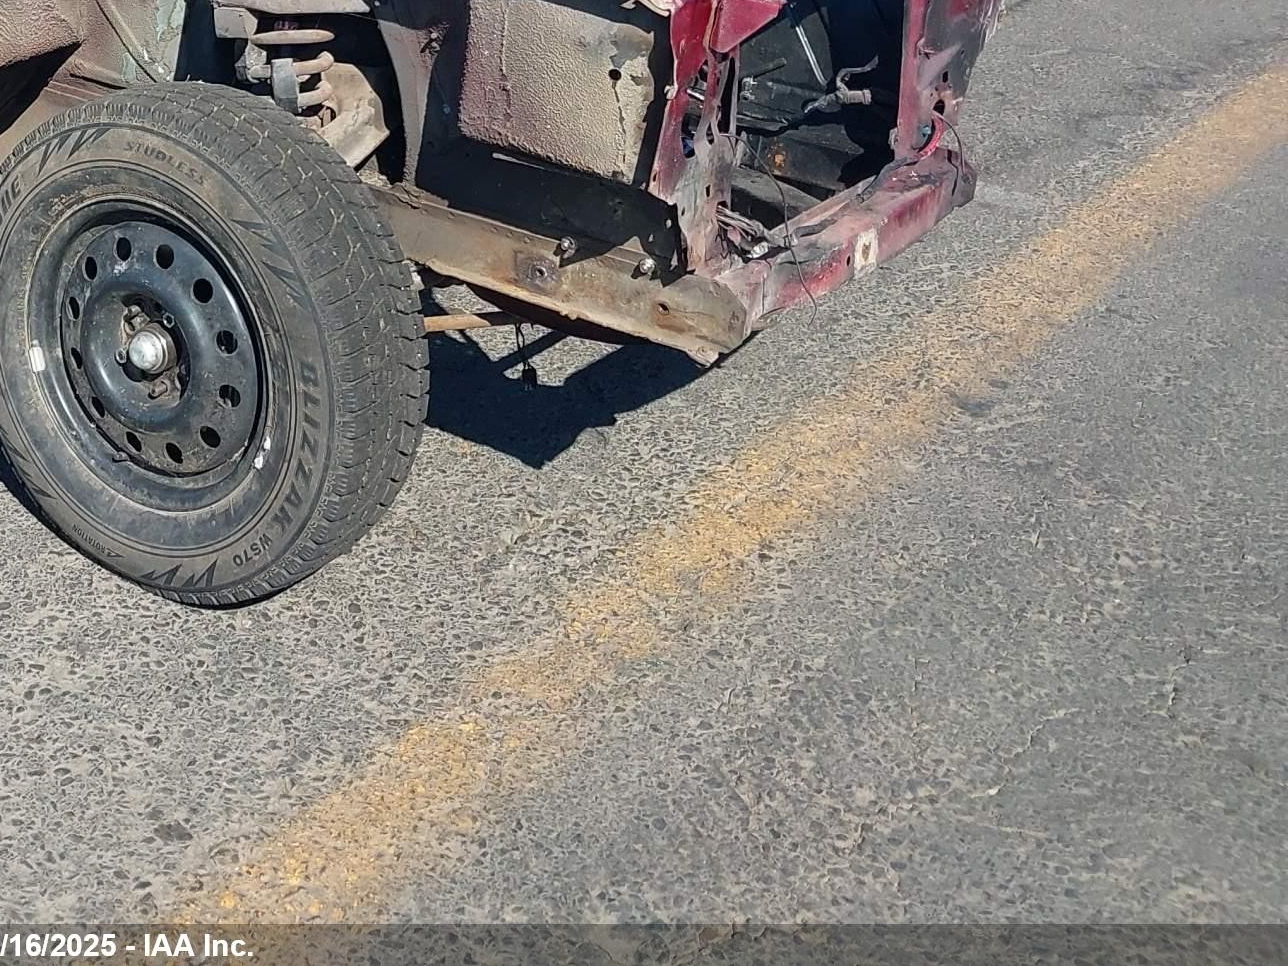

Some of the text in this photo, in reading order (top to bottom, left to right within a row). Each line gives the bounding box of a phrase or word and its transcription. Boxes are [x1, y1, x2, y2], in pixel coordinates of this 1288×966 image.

[125, 140, 206, 186] STUDLESS
[232, 359, 322, 568] BLIZZAK WS70
[72, 523, 107, 554] ROTATION
